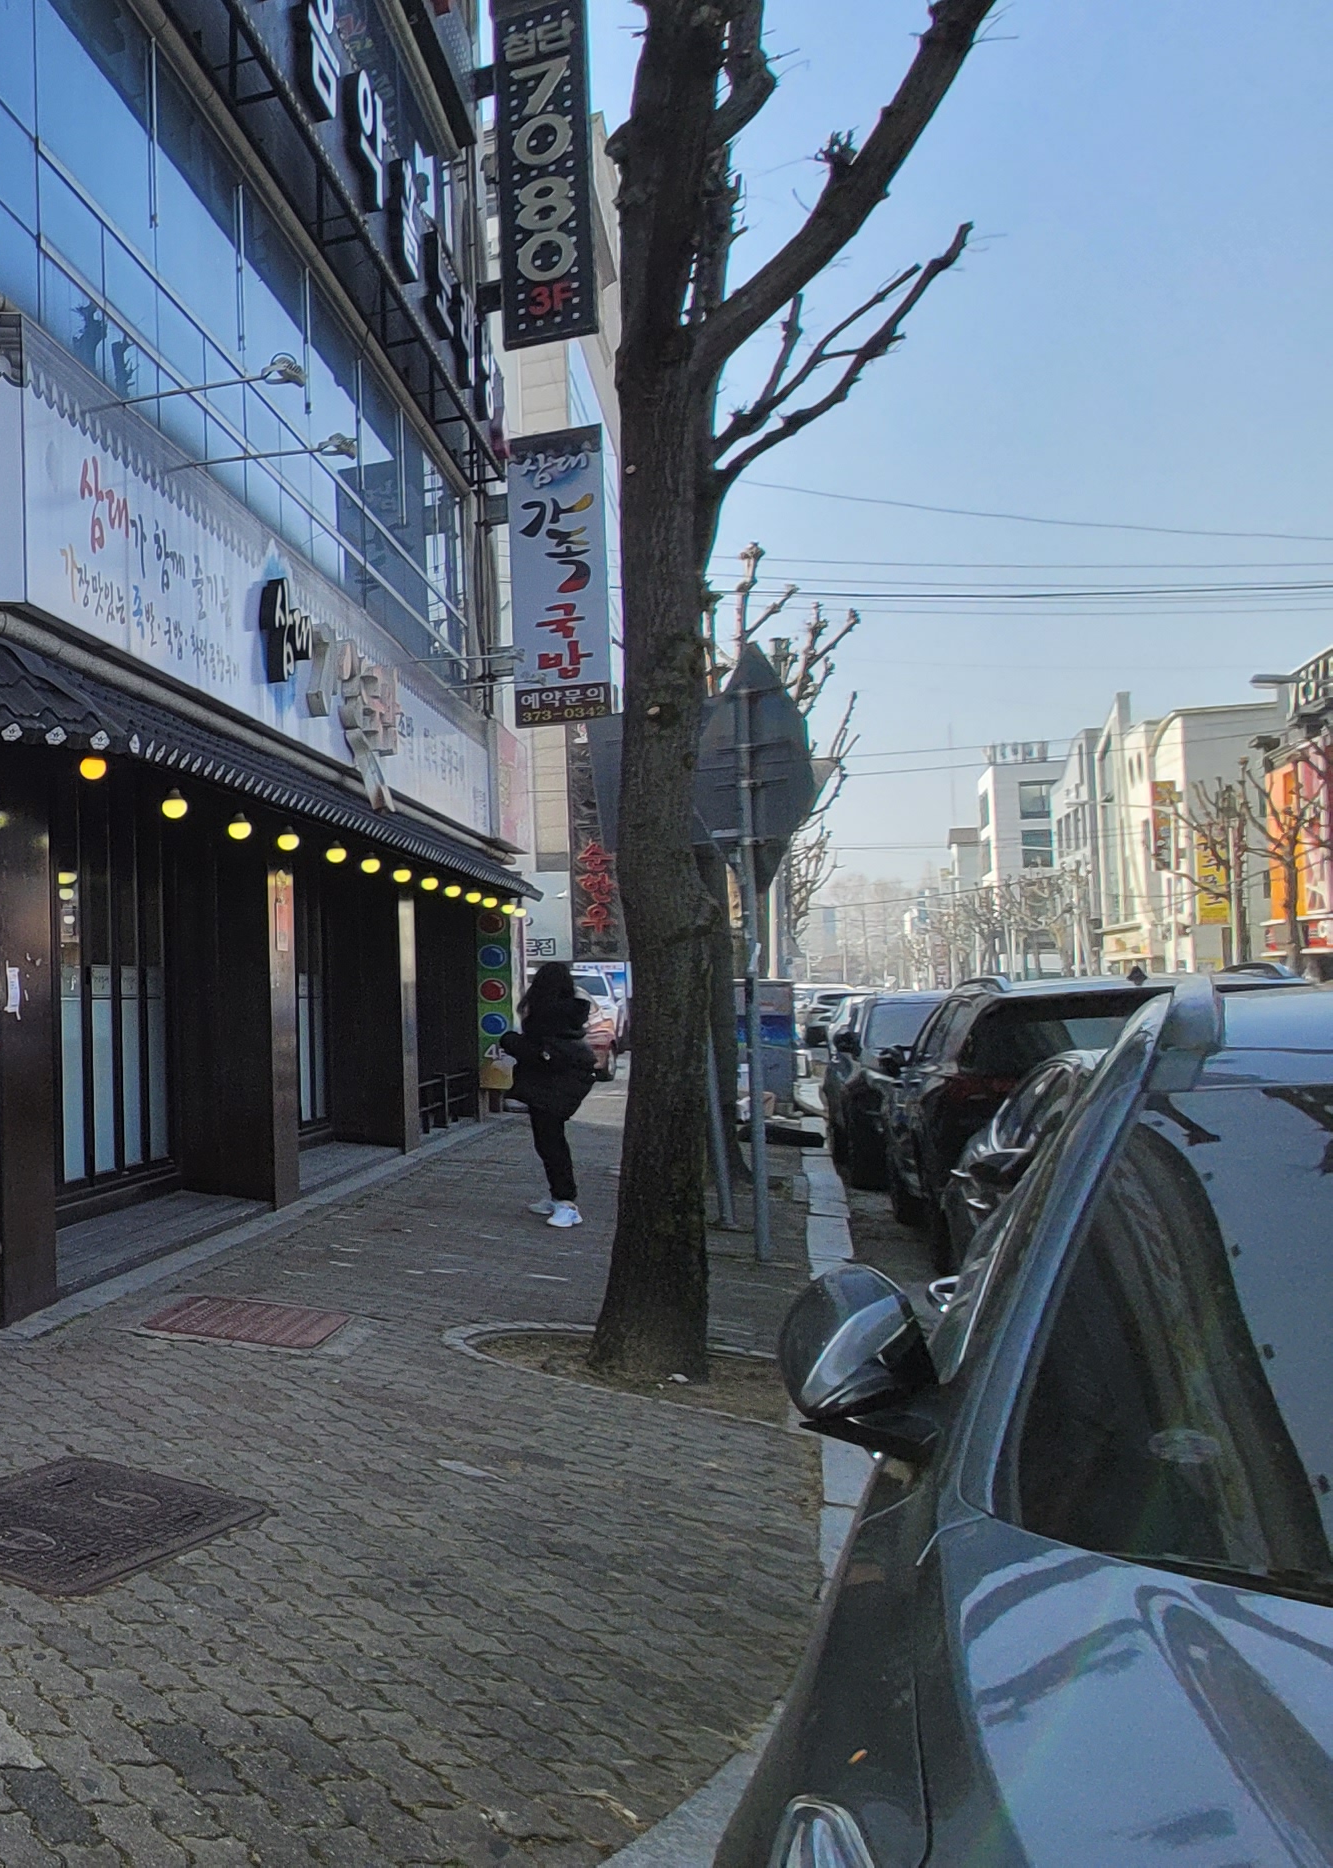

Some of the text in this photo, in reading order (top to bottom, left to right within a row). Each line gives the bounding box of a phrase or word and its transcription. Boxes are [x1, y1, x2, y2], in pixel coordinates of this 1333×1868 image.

[503, 19, 575, 61] 첨단
[511, 55, 577, 281] 7080
[528, 281, 573, 316] 3F
[520, 452, 590, 489] 삼대
[154, 519, 186, 594] 함께
[191, 553, 232, 628] 즐기는
[520, 685, 606, 711] 예약문의
[521, 704, 606, 723] 373-0342
